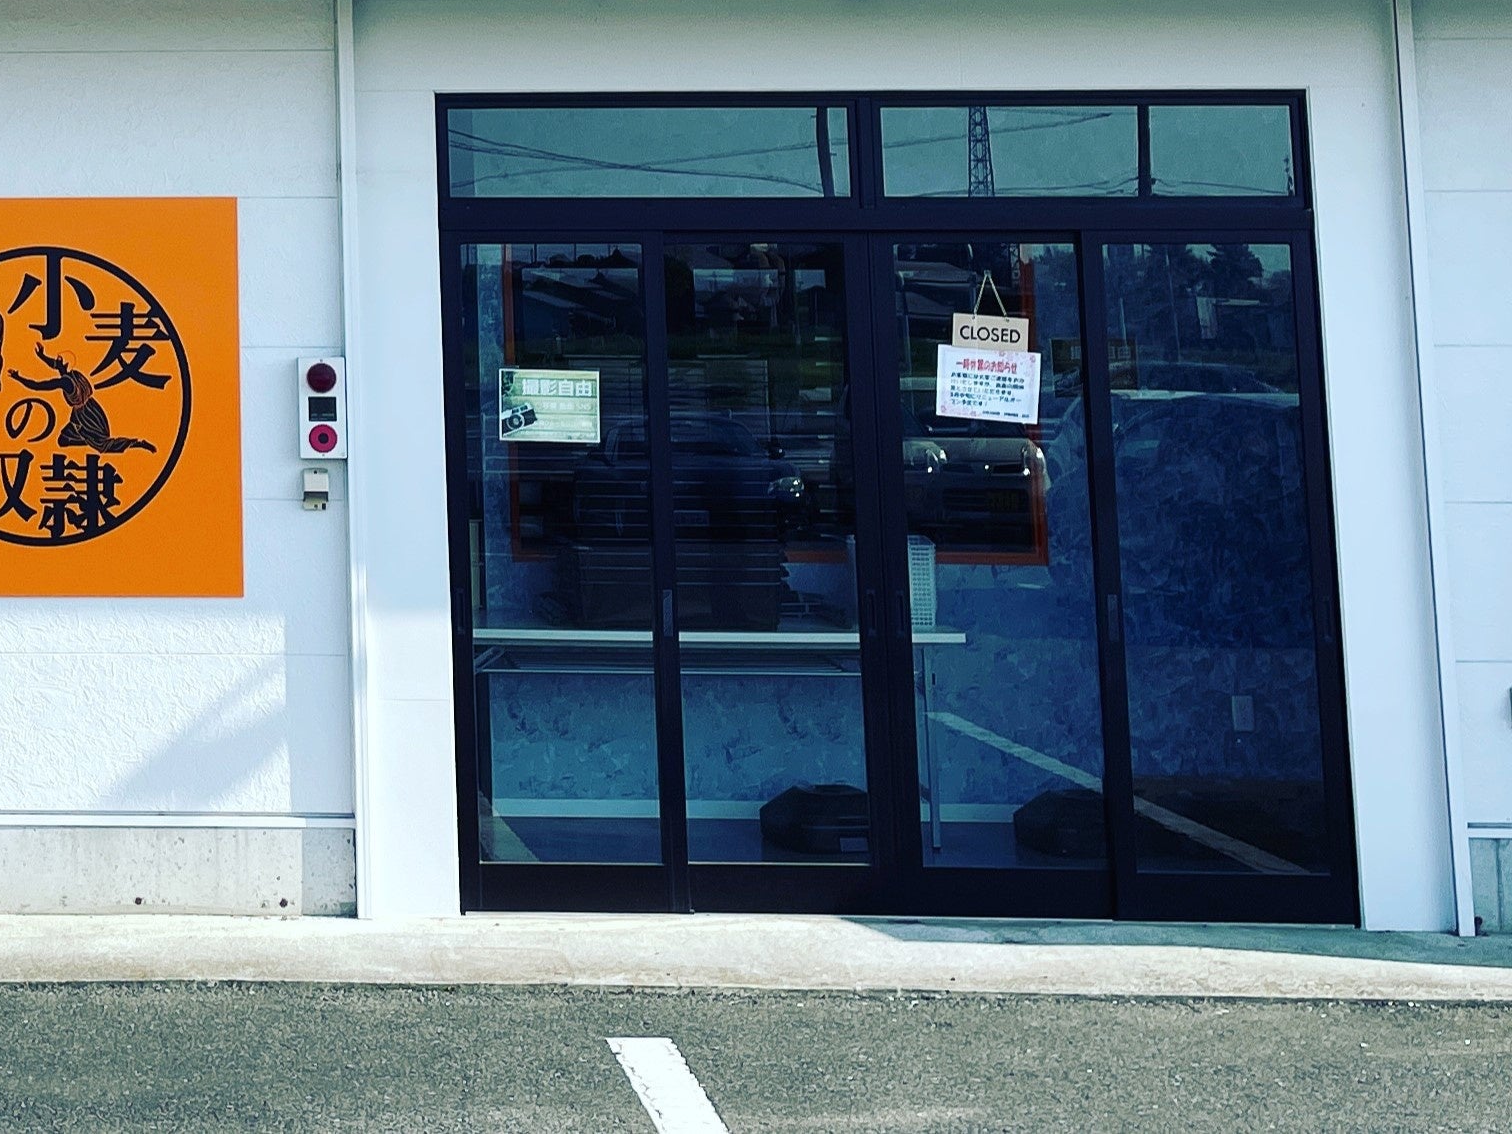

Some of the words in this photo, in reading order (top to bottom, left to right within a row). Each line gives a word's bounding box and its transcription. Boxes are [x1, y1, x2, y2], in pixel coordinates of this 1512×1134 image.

[7, 252, 173, 391] 小麦
[959, 324, 1021, 344] CLOSED
[522, 378, 592, 396] 撮影自由
[4, 397, 57, 443] の
